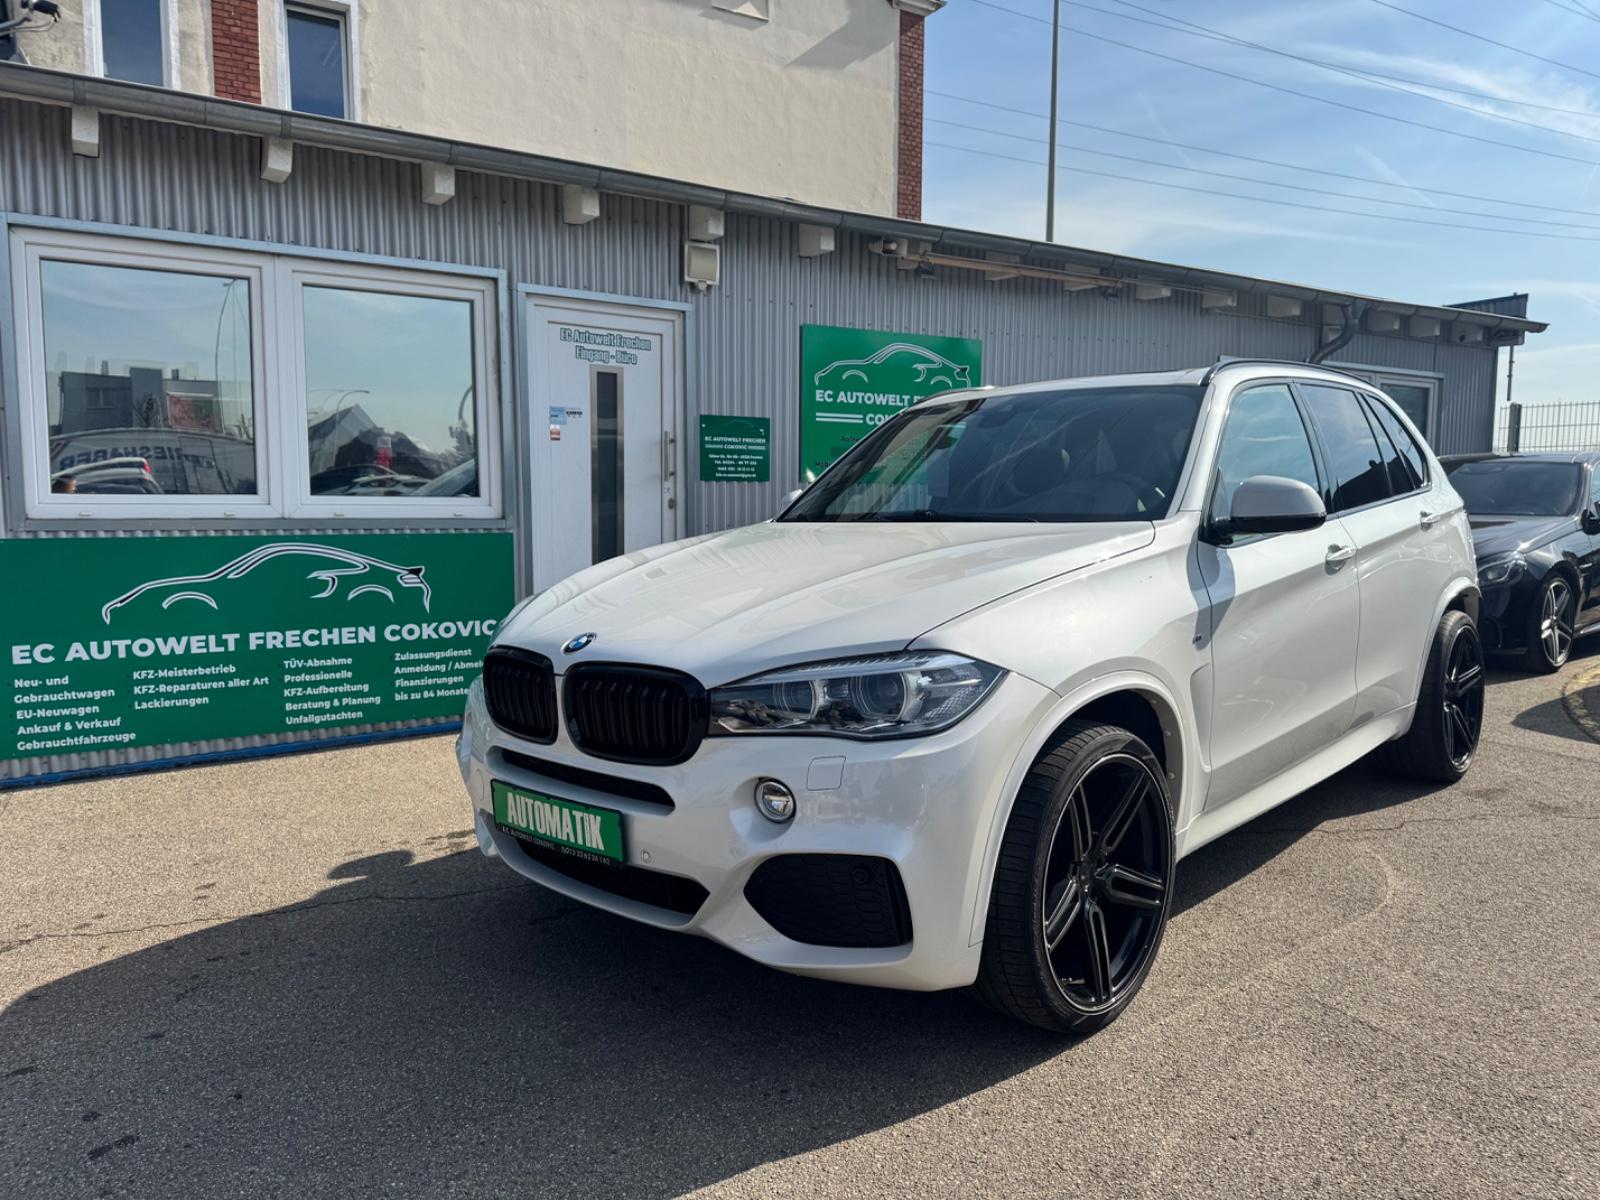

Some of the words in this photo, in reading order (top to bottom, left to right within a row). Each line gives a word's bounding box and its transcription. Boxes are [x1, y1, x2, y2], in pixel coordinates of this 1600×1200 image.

[560, 328, 572, 341] EC
[573, 329, 616, 346] Autowelt
[616, 334, 652, 351] Frechen
[576, 345, 610, 363] Eingang
[616, 350, 637, 364] Büro
[816, 390, 834, 402] EC
[837, 392, 909, 406] AUTOWELT
[11, 643, 55, 666] EC
[65, 632, 241, 662] AUTOWELT
[249, 625, 376, 650] FRECHEN
[384, 619, 497, 642] COKOVIC
[394, 648, 472, 661] Zulassungsdienst
[283, 657, 352, 668] TÜV-Abnahme
[394, 662, 446, 674] Anmeldung
[454, 659, 484, 670] Abmel
[133, 663, 236, 680] KFZ-Meisterbetrieb
[284, 670, 352, 683] Professionelle
[14, 678, 42, 688] Neu-
[46, 675, 69, 686] und
[134, 679, 225, 696] KFZ-Reparaturen
[227, 677, 250, 688] aller
[252, 675, 269, 687] Art
[395, 675, 464, 687] Finanzierungen
[14, 689, 115, 704] Gebrauchtwagen
[284, 683, 369, 697] KFZ-Aufbereitung
[395, 691, 408, 701] bis
[410, 691, 421, 699] zu
[134, 695, 209, 711] Lackierungen
[285, 700, 330, 711] Beratung
[342, 696, 381, 707] Planung
[16, 705, 100, 719] EU-Neuwagen
[286, 711, 363, 725] Unfallgutachten
[17, 722, 61, 735] Ankauf
[64, 722, 72, 731] &
[75, 717, 121, 730] Verkauf
[17, 732, 136, 751] Gebrauchtfahrzeuge
[507, 792, 604, 850] AUTOMATIK
